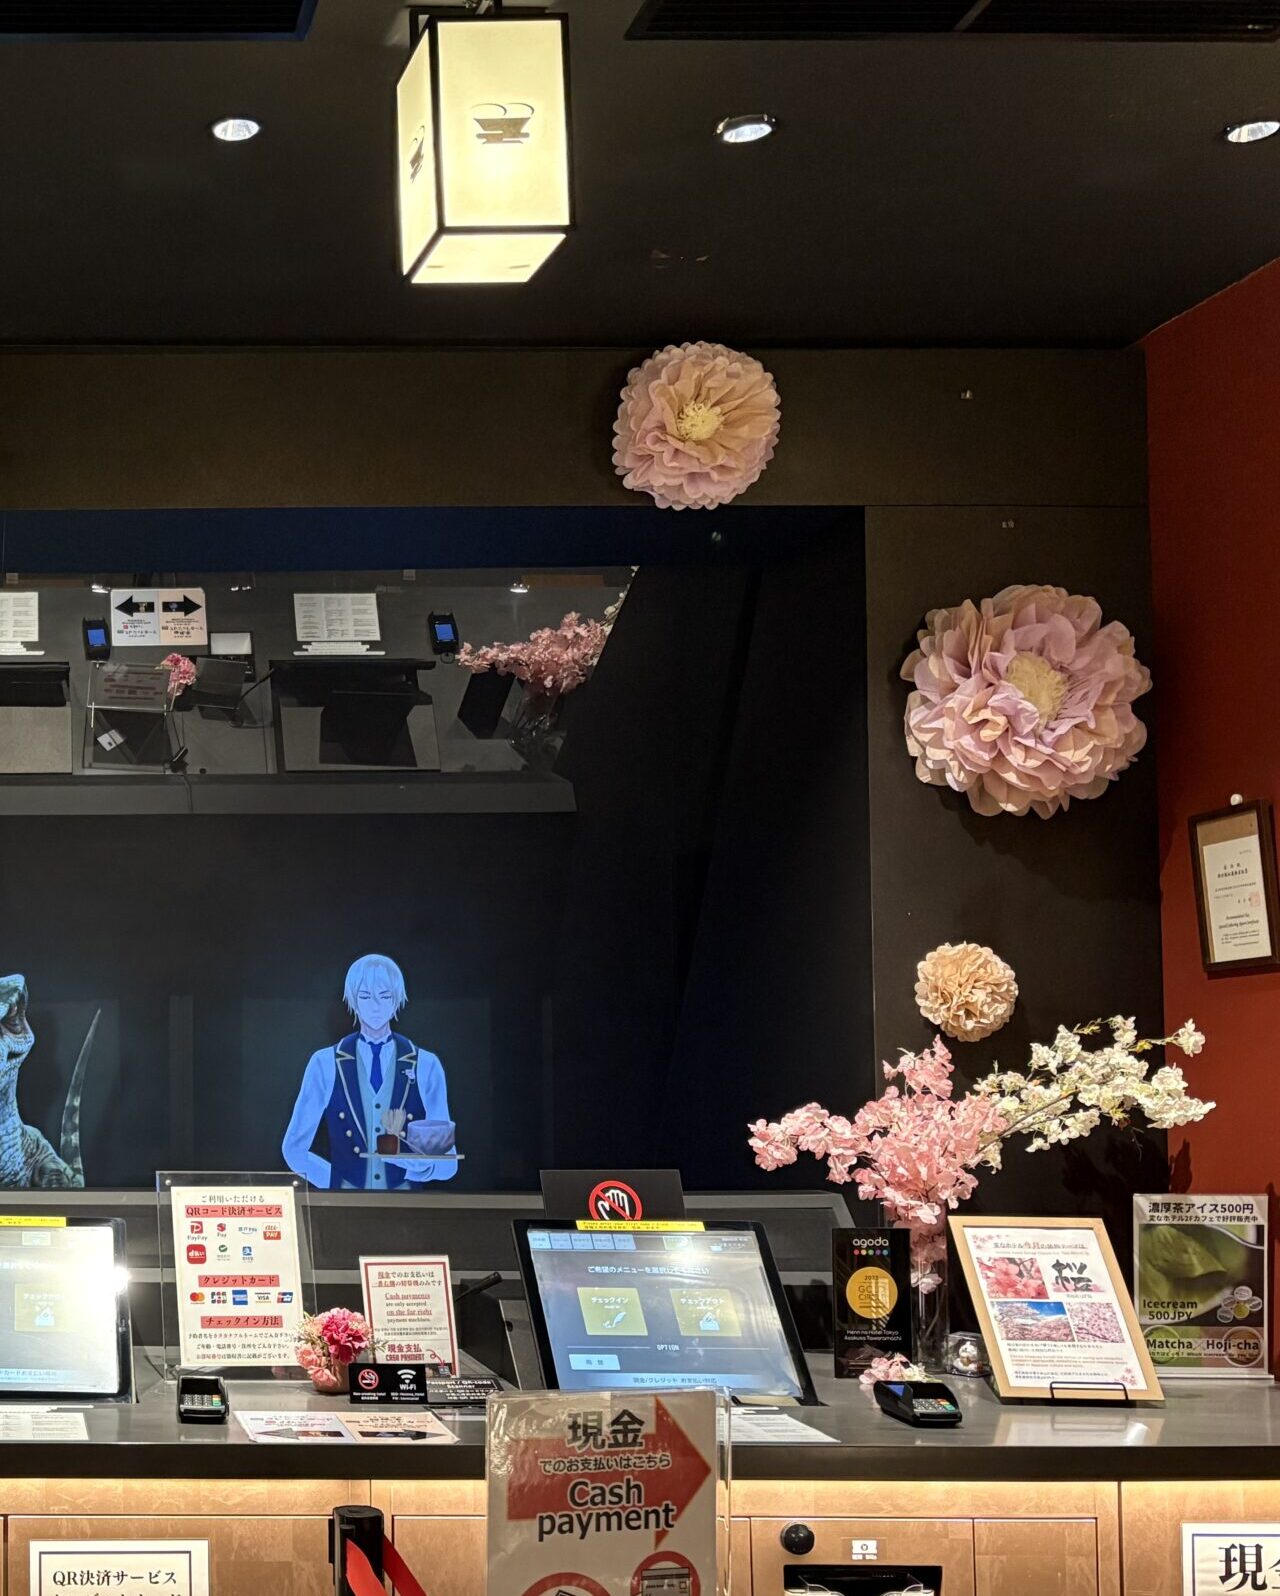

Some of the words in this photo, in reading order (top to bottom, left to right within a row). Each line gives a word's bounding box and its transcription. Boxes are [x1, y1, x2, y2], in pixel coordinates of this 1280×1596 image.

[202, 1195, 265, 1204] ご利用いただける
[186, 1207, 283, 1216] QRコード決済サービス
[1149, 1203, 1254, 1214] 濃厚茶アイス500円
[853, 1237, 889, 1248] agoda
[203, 1276, 276, 1285] クレジットカード
[1052, 1259, 1093, 1292] 桜
[1143, 1300, 1198, 1309] Icecream
[206, 1316, 280, 1326] チェックイン方法
[1149, 1311, 1193, 1320] 500JPY
[388, 1344, 422, 1353] 現金支払
[1147, 1339, 1193, 1350] Matcha
[1207, 1340, 1259, 1352] Hoji-cha
[567, 1409, 645, 1450] 現金
[540, 1454, 671, 1473] でのお支払いはこちら
[570, 1478, 642, 1507] Cash
[539, 1504, 675, 1542] payment
[53, 1570, 177, 1586] QR決済サービス
